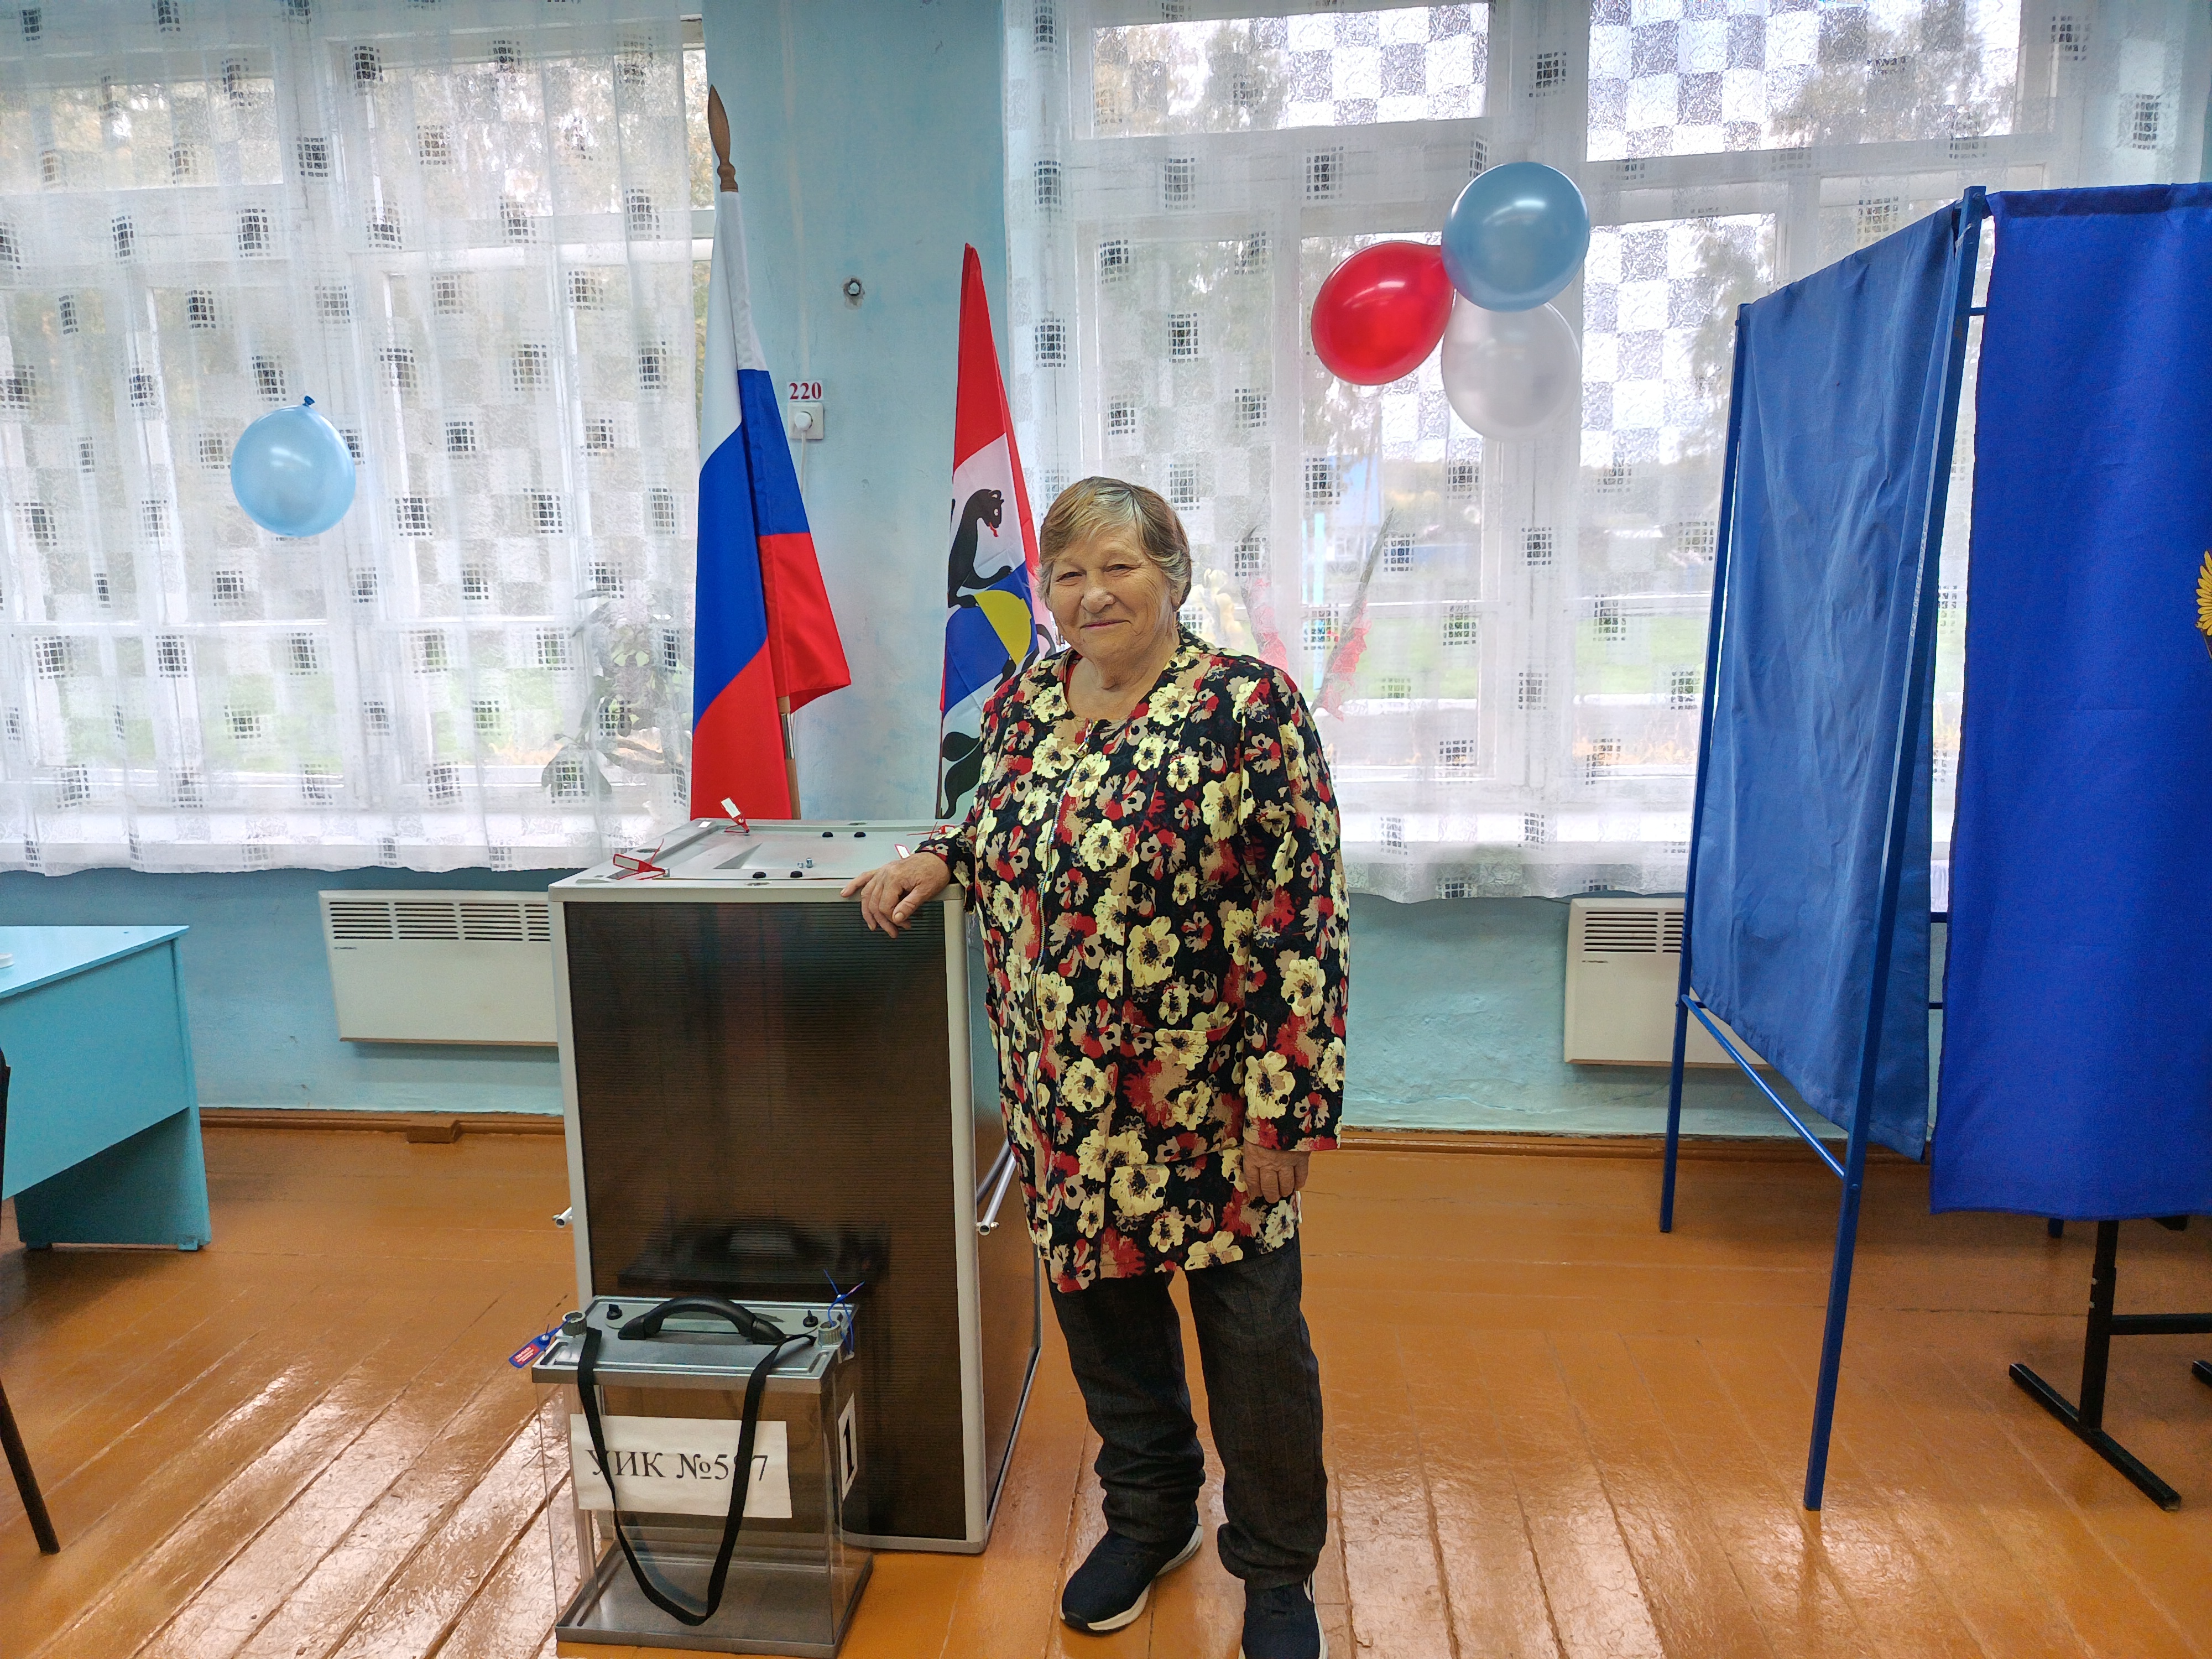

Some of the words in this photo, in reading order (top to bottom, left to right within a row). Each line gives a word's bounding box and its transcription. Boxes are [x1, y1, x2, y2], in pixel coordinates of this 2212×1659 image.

[789, 382, 822, 400] 220
[843, 1415, 855, 1485] 1
[676, 1453, 768, 1481] №57
